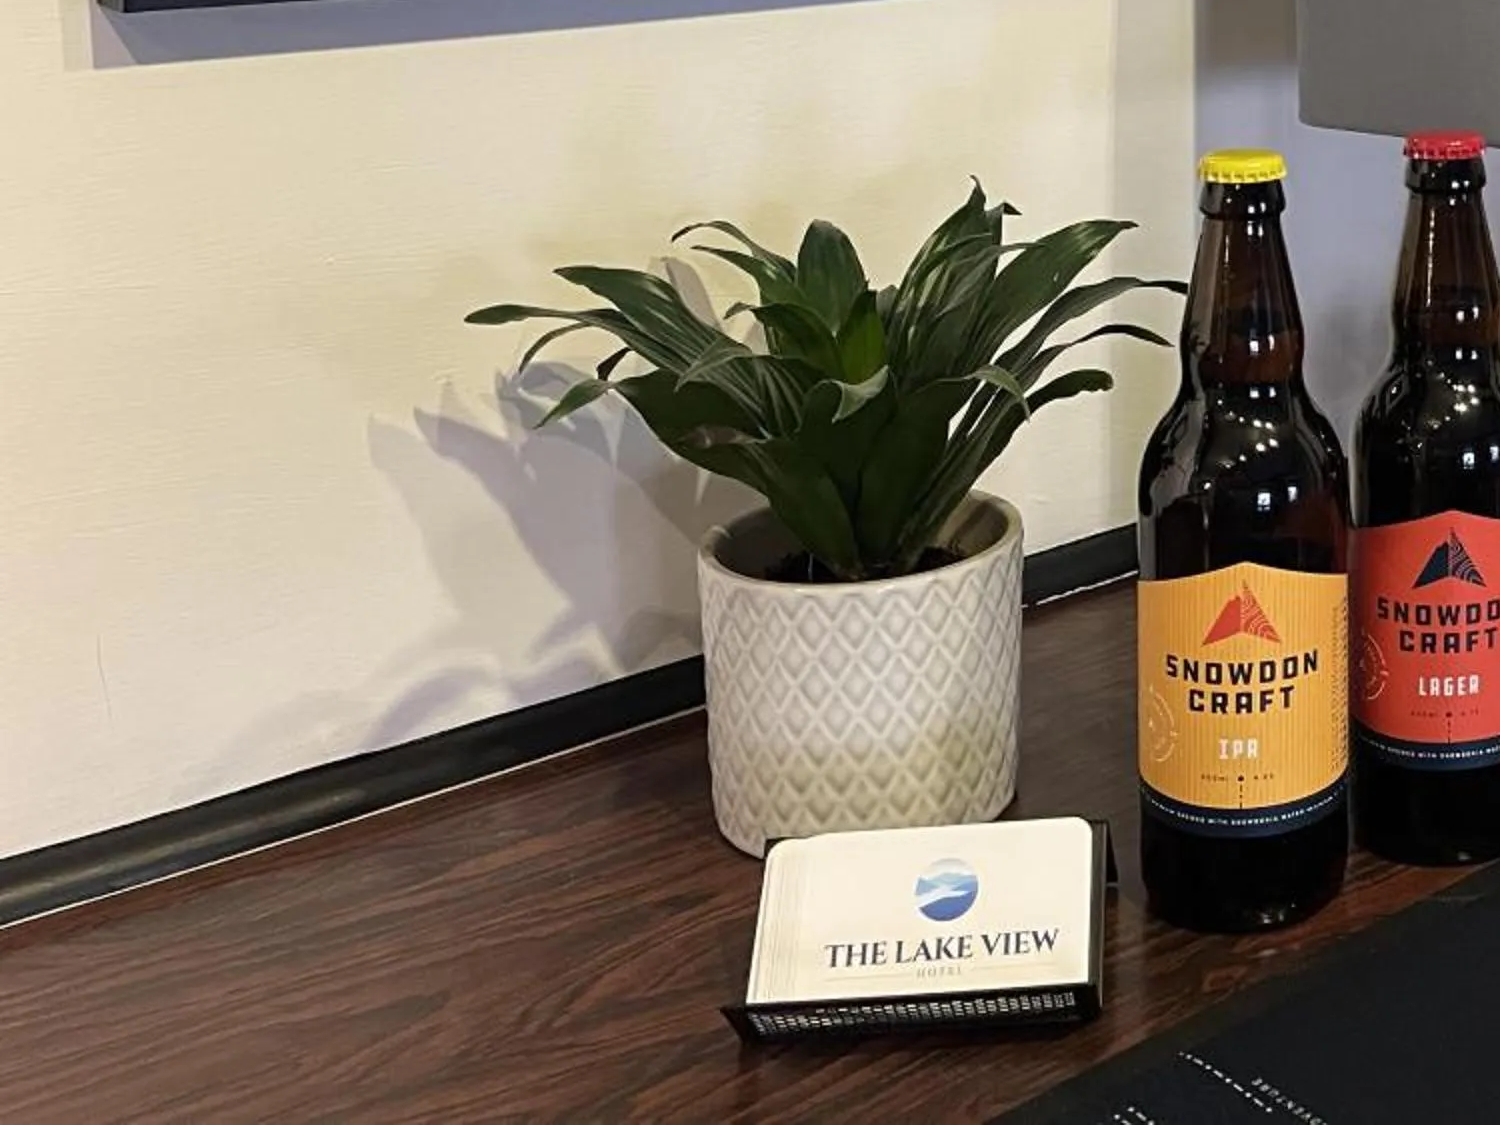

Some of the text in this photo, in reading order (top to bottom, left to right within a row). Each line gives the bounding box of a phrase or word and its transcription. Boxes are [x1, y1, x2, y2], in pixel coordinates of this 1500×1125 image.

[1399, 628, 1499, 655] CRAFT
[1165, 649, 1319, 687] SNOWDON
[1418, 674, 1480, 697] LAGER
[1188, 686, 1295, 714] CRAFT
[1218, 738, 1259, 761] IPA
[825, 928, 1060, 968] THE LAKE VIEW
